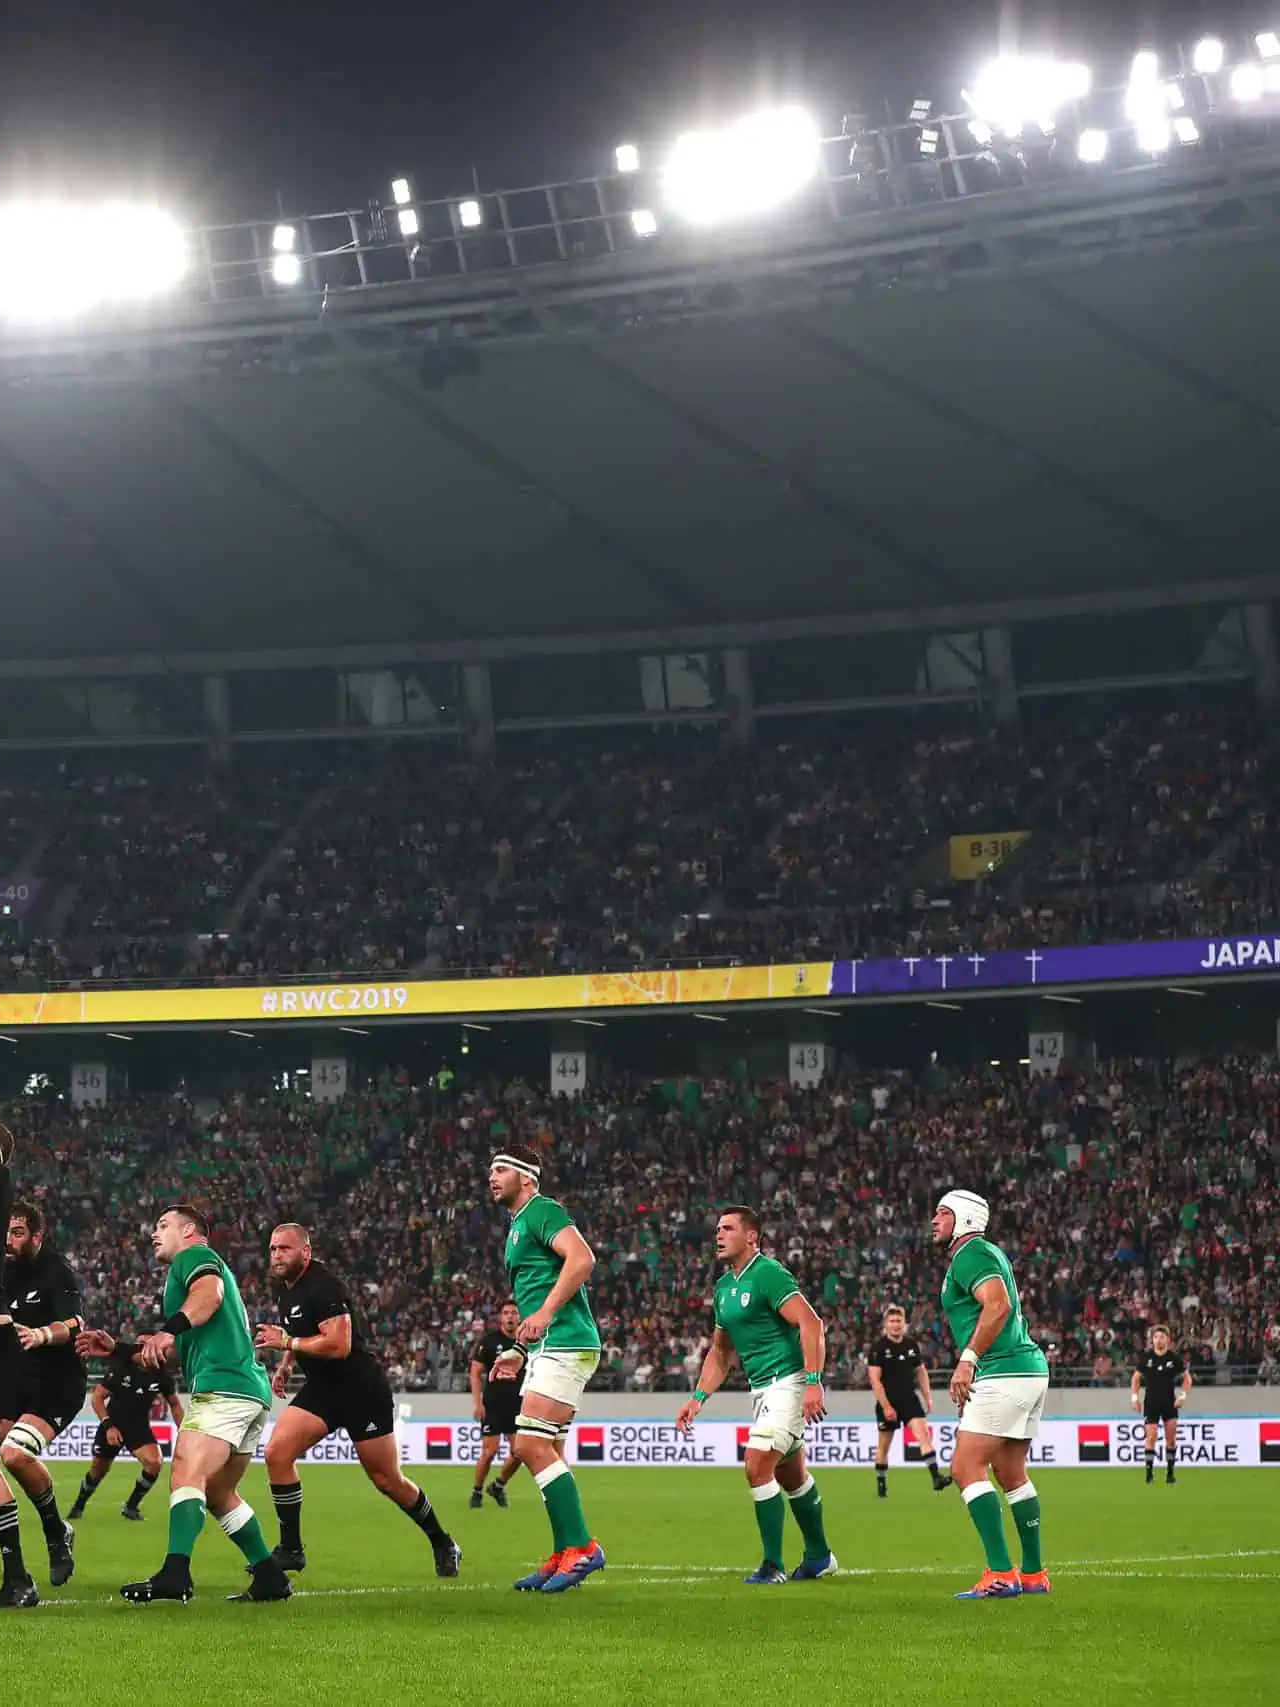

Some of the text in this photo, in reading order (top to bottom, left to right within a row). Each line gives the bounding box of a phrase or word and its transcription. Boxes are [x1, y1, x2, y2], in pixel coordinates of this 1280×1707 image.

[262, 987, 408, 1013] #RWC2019
[1035, 1038, 1058, 1058] 42
[76, 1067, 100, 1088] 46
[556, 1058, 580, 1078] 44
[804, 1426, 861, 1442] CIETE
[610, 1446, 716, 1462] GENERALE
